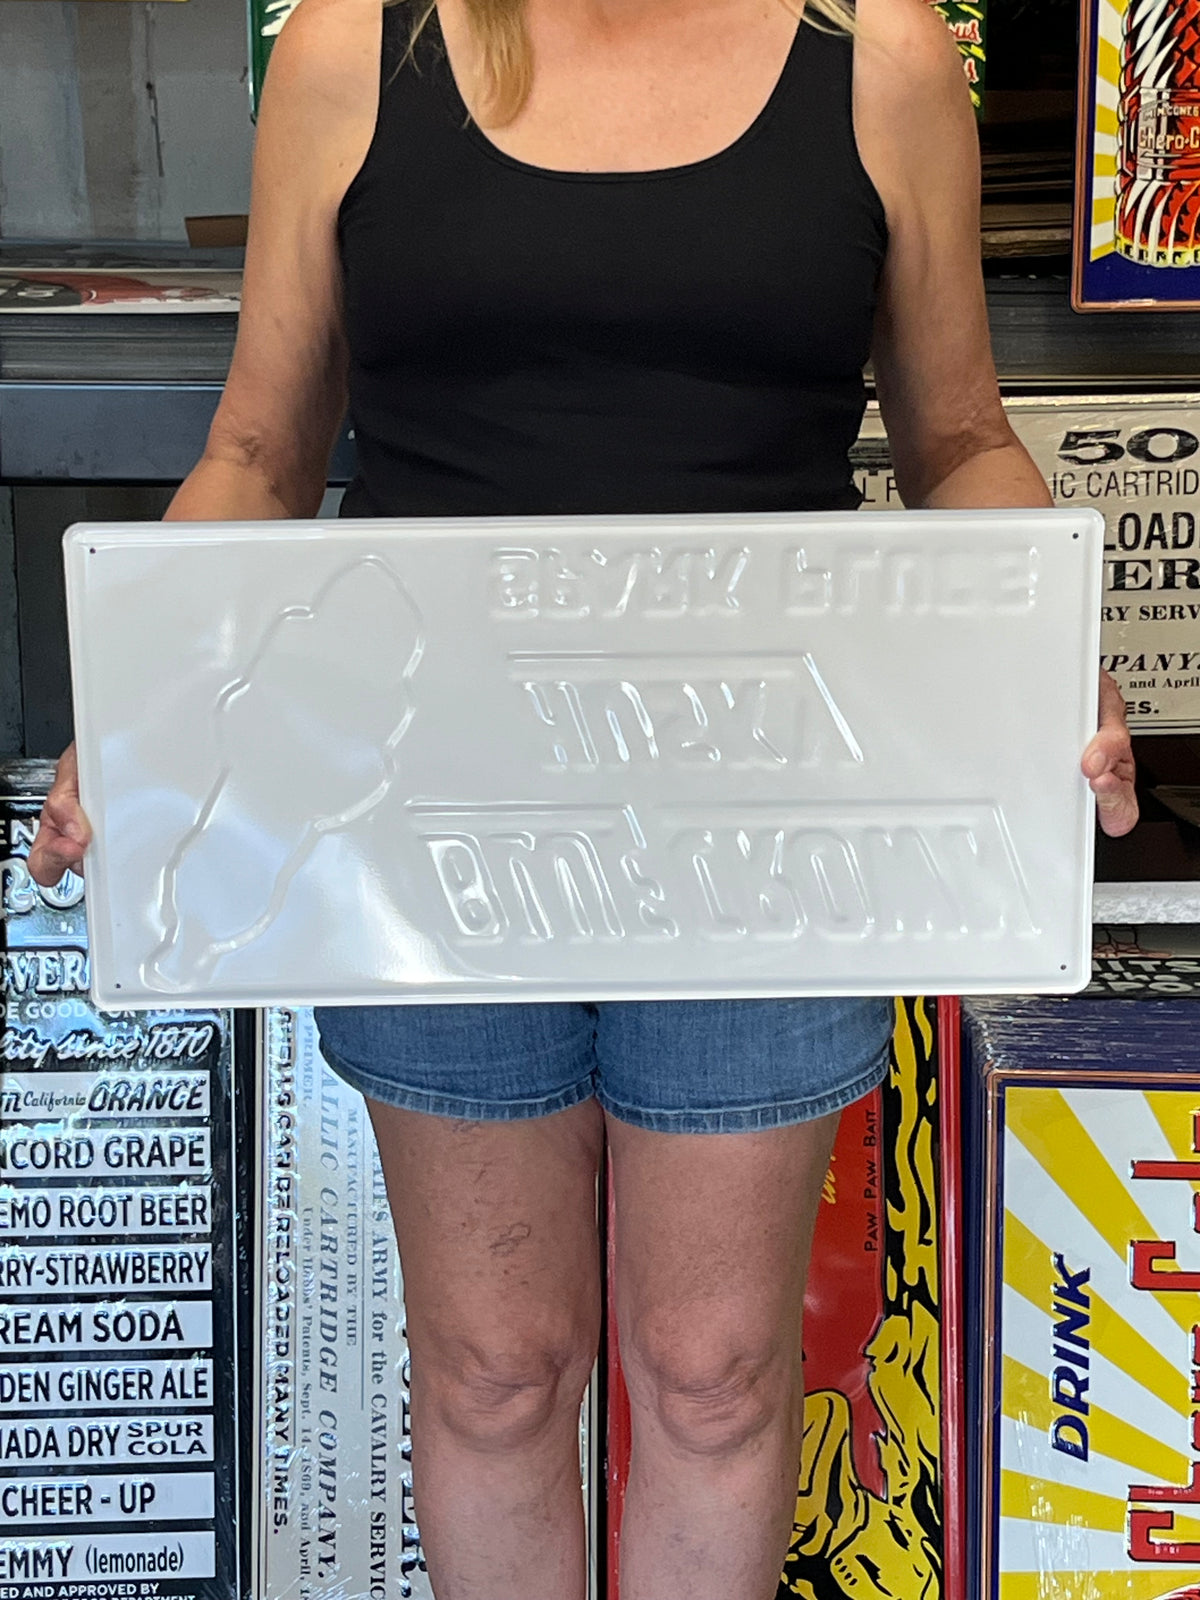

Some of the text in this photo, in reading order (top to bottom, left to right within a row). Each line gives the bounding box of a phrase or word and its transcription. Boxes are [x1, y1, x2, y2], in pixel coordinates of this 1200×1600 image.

[1057, 428, 1200, 465] 50
[1087, 469, 1200, 497] CARTRID
[25, 1001, 87, 1019] GOOD
[144, 1023, 214, 1060] 1870
[24, 1091, 87, 1113] California
[88, 1078, 207, 1112] ORANGE
[104, 1135, 205, 1168] GRAPE
[276, 1115, 291, 1167] CAN
[276, 1177, 291, 1209] BE
[864, 1110, 878, 1252] PAW PAW BAIT
[60, 1194, 133, 1228] ROOT
[141, 1193, 208, 1227] BEER
[346, 1108, 358, 1347] MANUFACTURED BY THE
[371, 1231, 388, 1302] ARMY
[274, 1217, 291, 1358] RELOADED
[319, 1187, 339, 1394] CARTRIDGE
[94, 1309, 184, 1343] SODA
[371, 1311, 388, 1342] for
[371, 1352, 388, 1385] the
[1052, 1252, 1091, 1462] DRINK
[0, 1366, 208, 1403] DEN GINGER ALE
[274, 1366, 290, 1441] MANY
[0, 1421, 203, 1459] ADA DRY SPUR
[128, 1440, 207, 1456] COLA
[370, 1394, 387, 1502] CAVALRY
[2, 1483, 93, 1517] CHEER
[120, 1481, 155, 1514] UP
[273, 1453, 289, 1535] TIMES.
[317, 1410, 338, 1579] COMPANY.
[86, 1543, 184, 1575] (lemonade)
[23, 1586, 55, 1599] AND
[58, 1584, 137, 1597] APPROVED
[140, 1583, 160, 1595] BY
